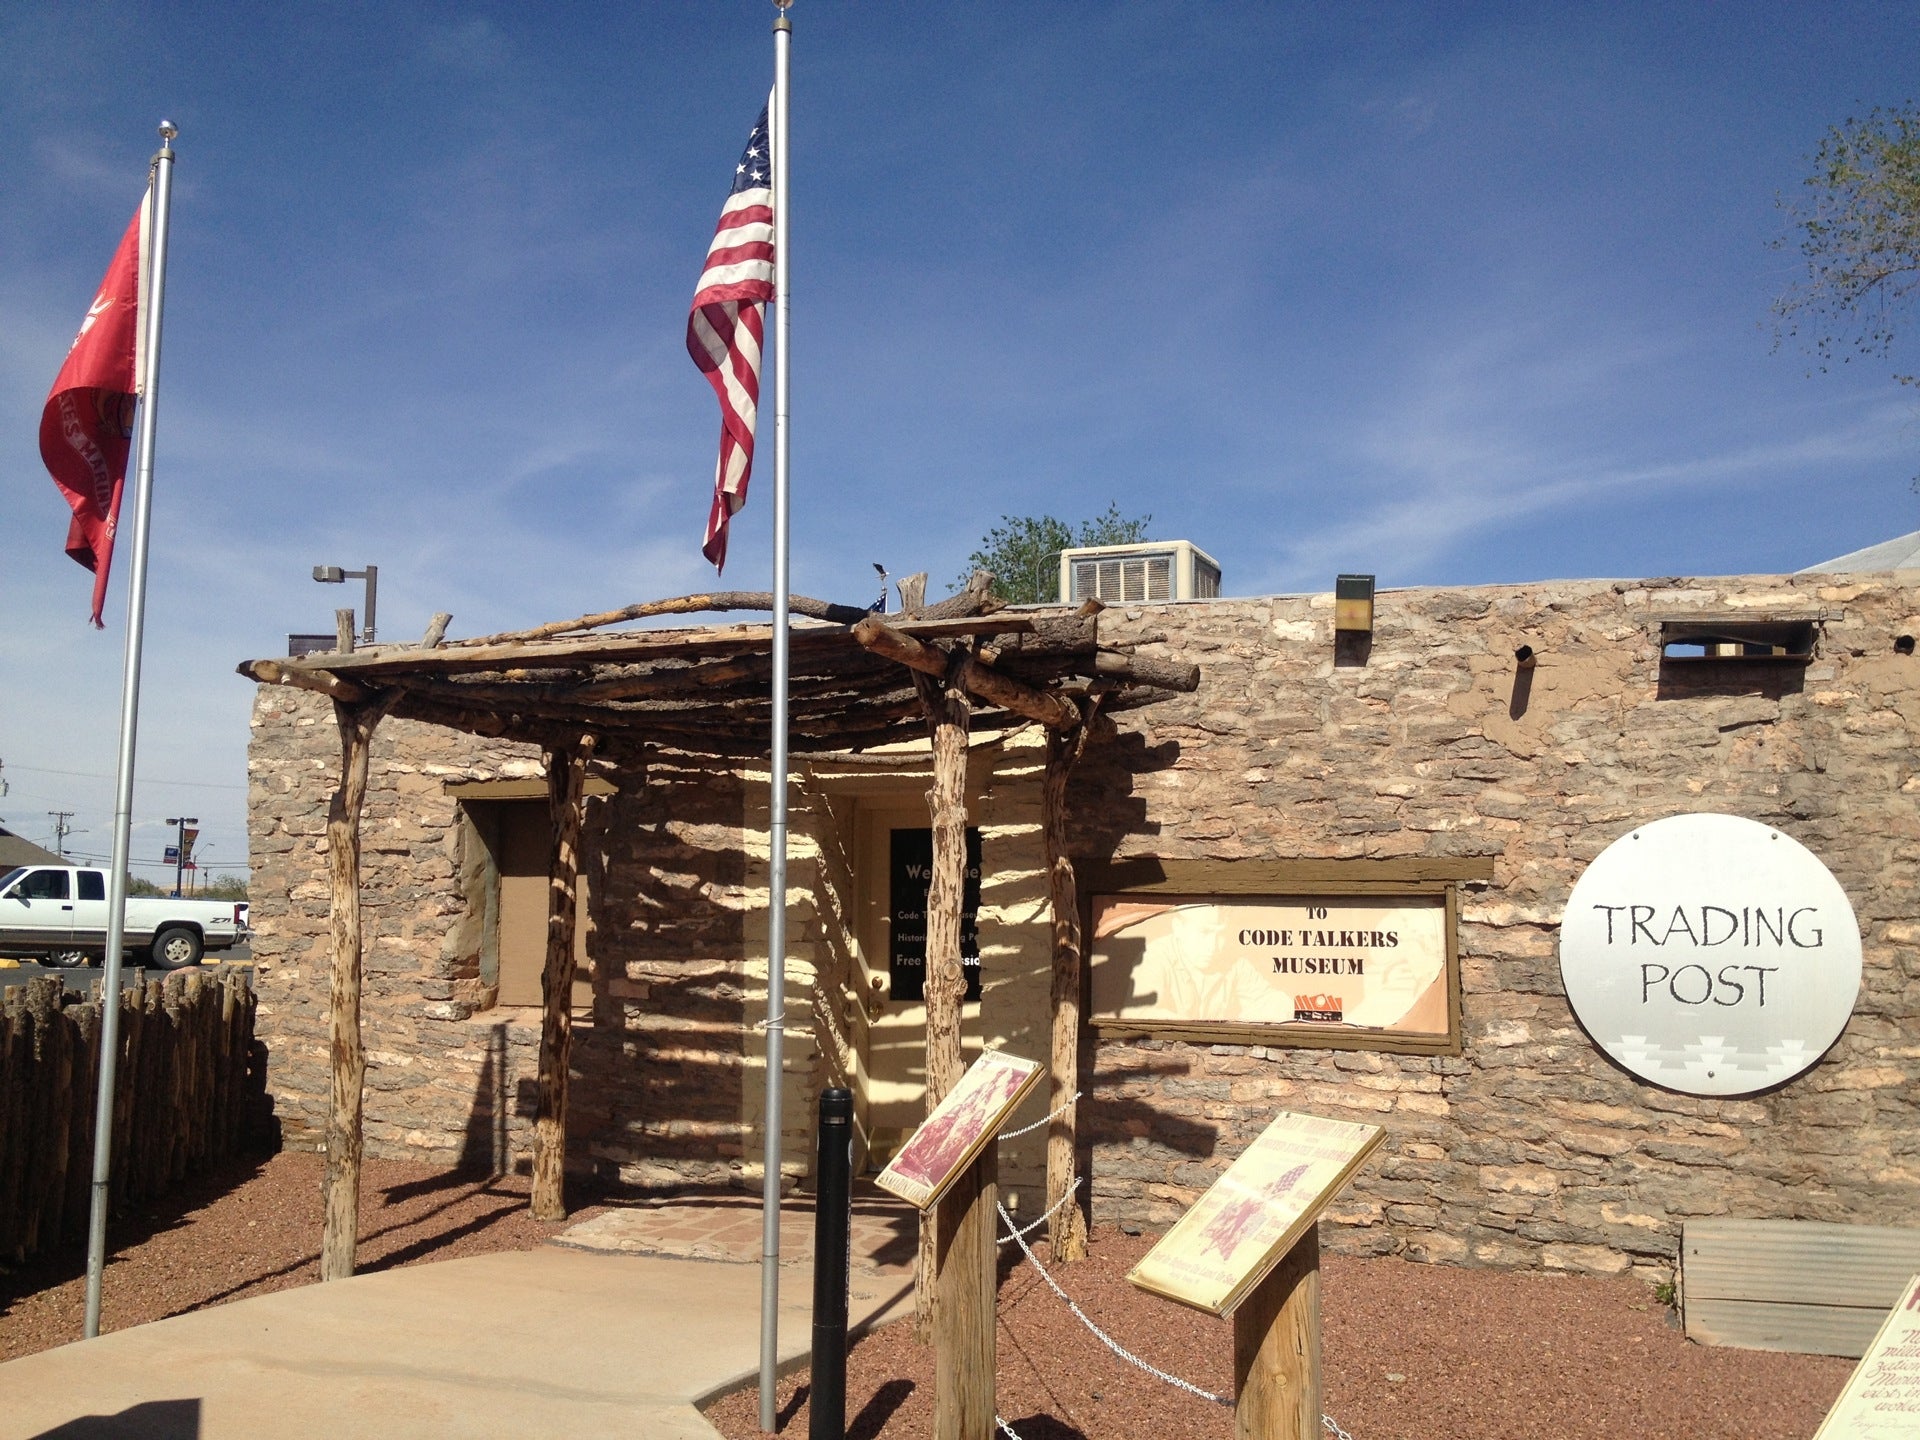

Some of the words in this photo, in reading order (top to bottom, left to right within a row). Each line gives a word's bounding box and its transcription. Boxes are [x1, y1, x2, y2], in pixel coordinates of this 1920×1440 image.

[897, 910, 919, 920] Code
[1305, 906, 1328, 920] TO
[1593, 904, 1823, 948] TRADING
[1238, 929, 1293, 947] CODE
[1299, 930, 1399, 948] TALKERS
[896, 954, 921, 966] Free
[1272, 957, 1364, 976] MUSEUM
[1640, 964, 1779, 1007] POST
